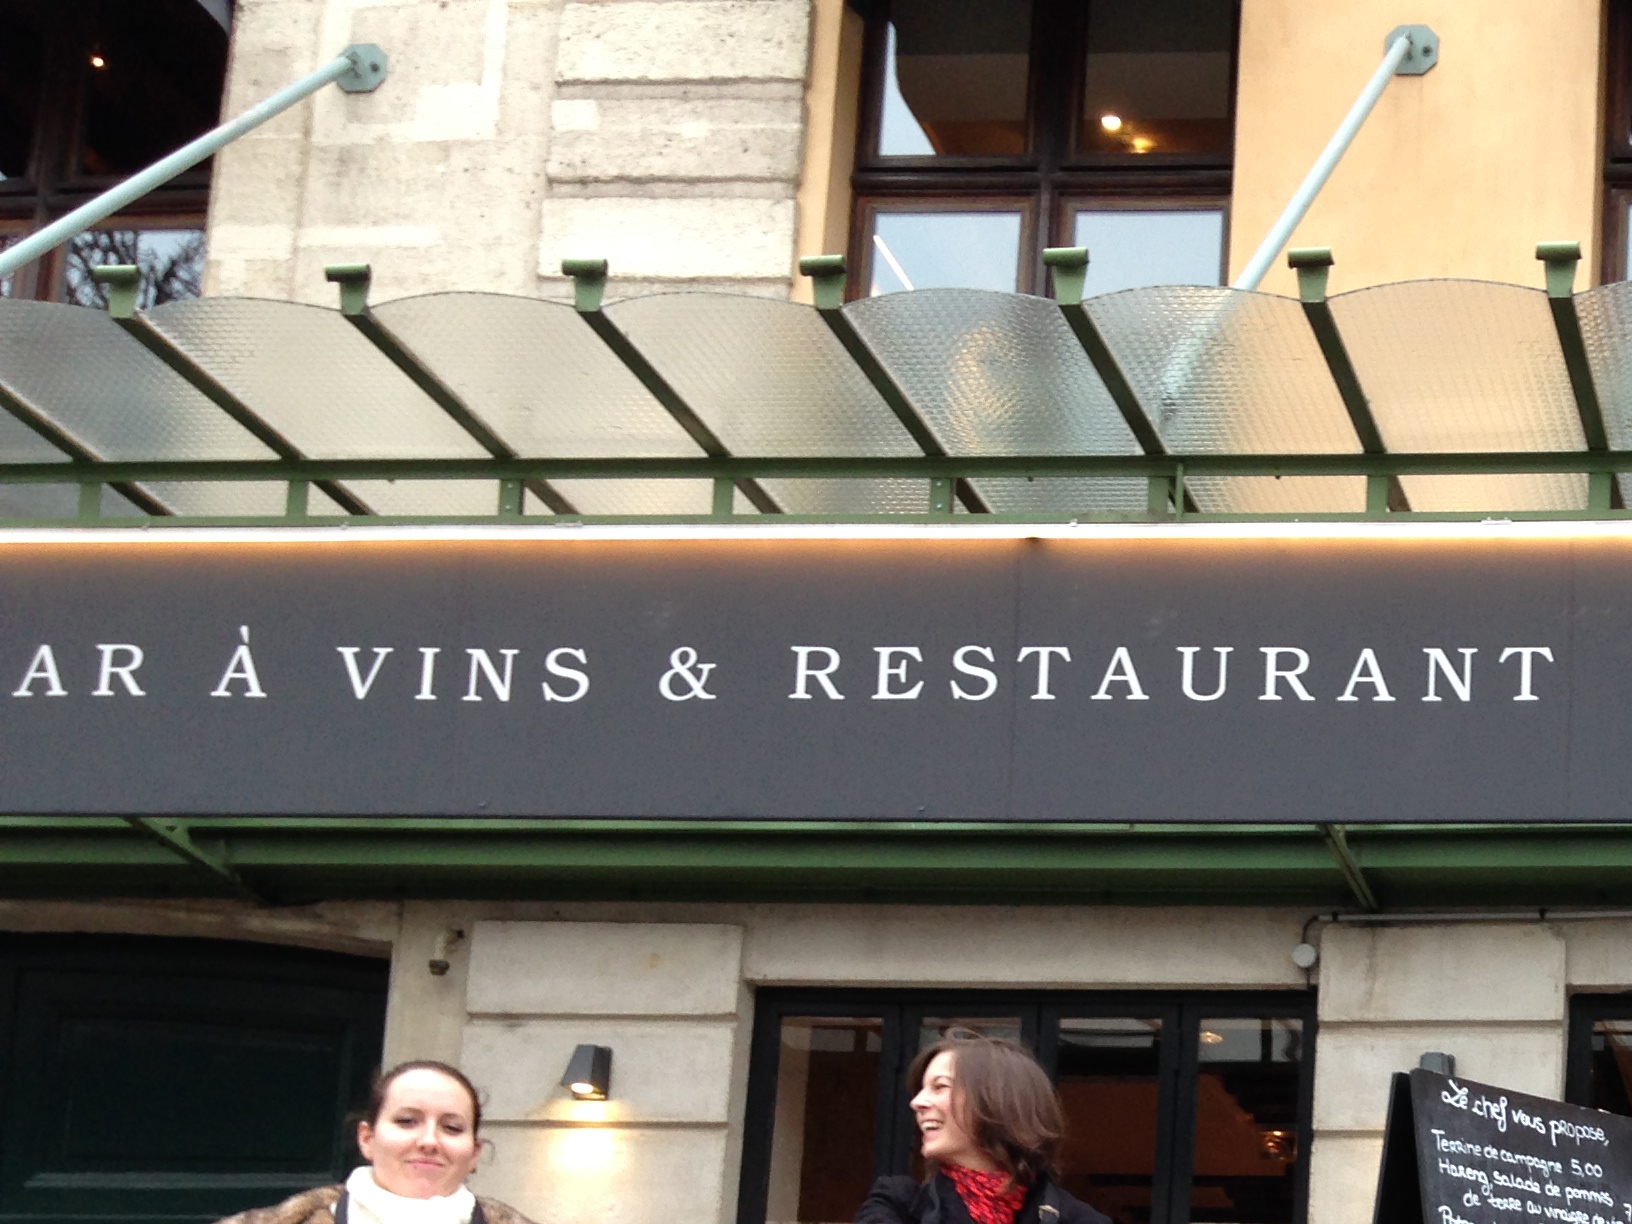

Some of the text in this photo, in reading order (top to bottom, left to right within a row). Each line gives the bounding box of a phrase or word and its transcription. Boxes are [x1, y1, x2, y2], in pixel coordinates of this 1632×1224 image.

[12, 625, 1556, 703] AR À VINS & RESTAURANT
[1441, 1079, 1469, 1109] Le
[1471, 1095, 1508, 1132] chef
[1511, 1109, 1546, 1134] vous
[1483, 1144, 1499, 1160] de
[1500, 1149, 1562, 1178] campagne
[1571, 1158, 1603, 1178] 5,00
[1463, 1188, 1481, 1207] de
[1545, 1179, 1562, 1197] de
[1565, 1186, 1614, 1207] pommes
